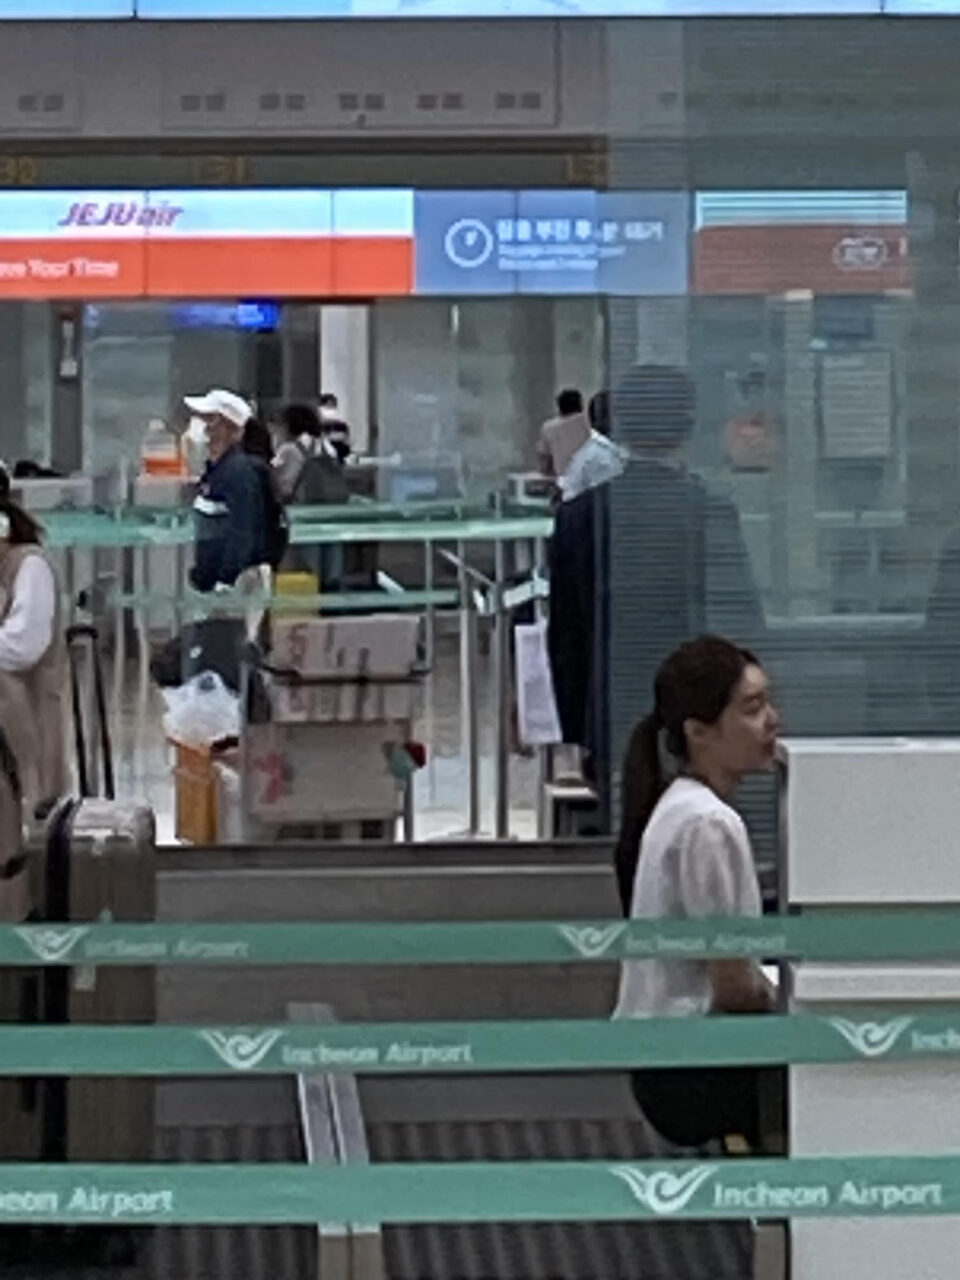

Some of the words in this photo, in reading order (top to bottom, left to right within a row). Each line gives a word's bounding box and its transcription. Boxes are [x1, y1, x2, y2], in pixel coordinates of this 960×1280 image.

[282, 1041, 379, 1065] Incheon
[386, 1040, 472, 1067] Airport
[66, 1185, 174, 1218] Airport
[712, 1180, 828, 1208] Incheon
[839, 1177, 941, 1208] Airport
